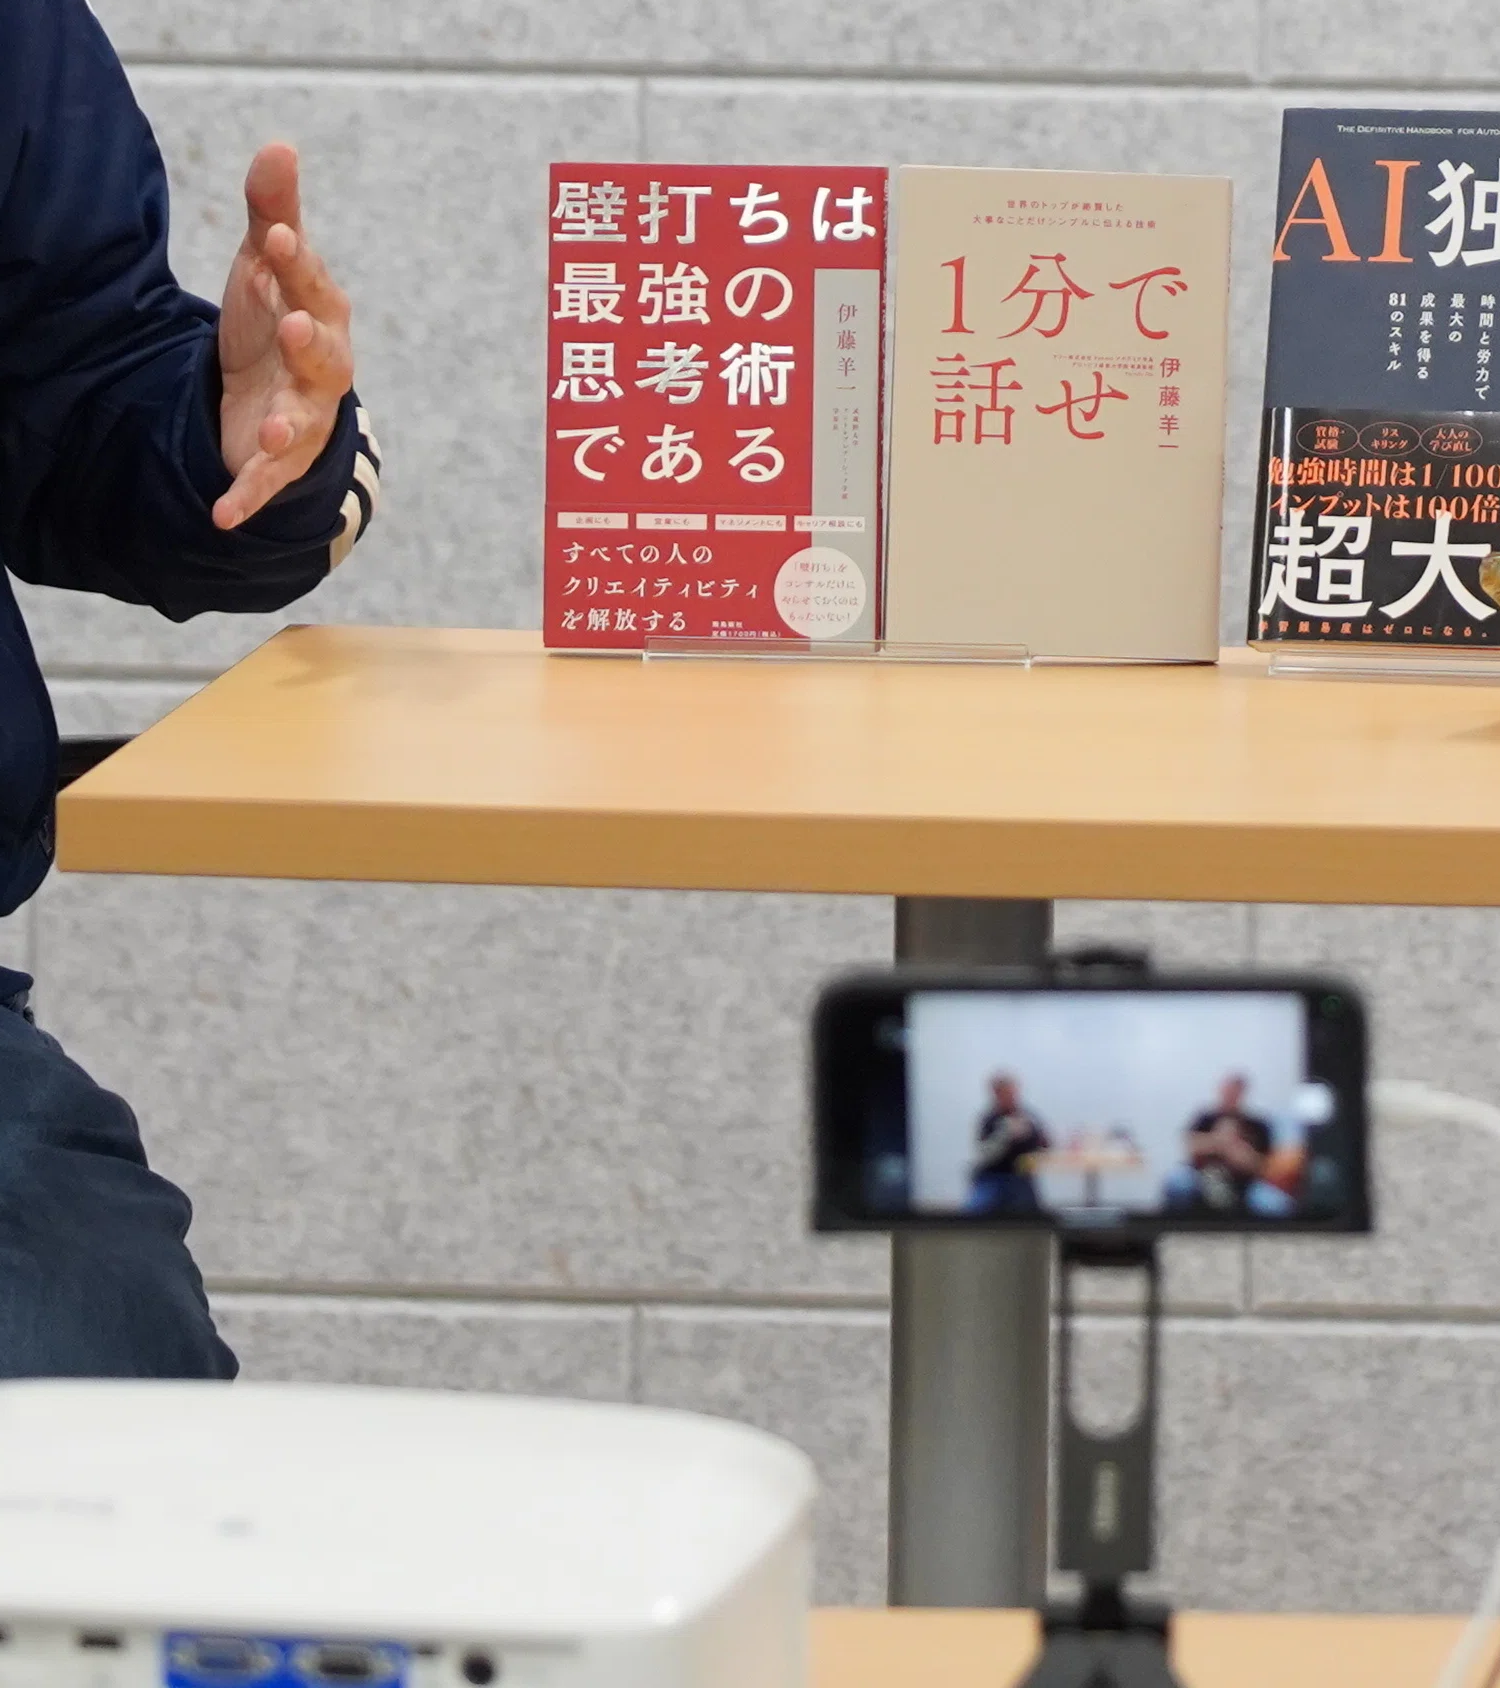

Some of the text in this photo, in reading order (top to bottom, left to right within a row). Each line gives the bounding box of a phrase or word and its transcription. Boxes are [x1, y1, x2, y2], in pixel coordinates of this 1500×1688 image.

[552, 181, 877, 244] 壁打ちは
[553, 262, 794, 325] 最強の
[940, 252, 1188, 340] 1分で
[1448, 293, 1466, 343] 最大の
[835, 303, 858, 390] 伊藤羊一
[1386, 292, 1407, 371] 81のスキル
[1416, 292, 1436, 379] 成果を得る
[1475, 293, 1495, 400] 時間と労力で
[552, 341, 795, 406] 思考術
[929, 353, 1129, 445] 話せ
[1158, 357, 1181, 449] 伊藤羊一
[556, 424, 785, 484] である
[562, 541, 713, 565] すべての人の
[561, 576, 759, 599] クリエイティビティ
[561, 607, 687, 632] を解放する
